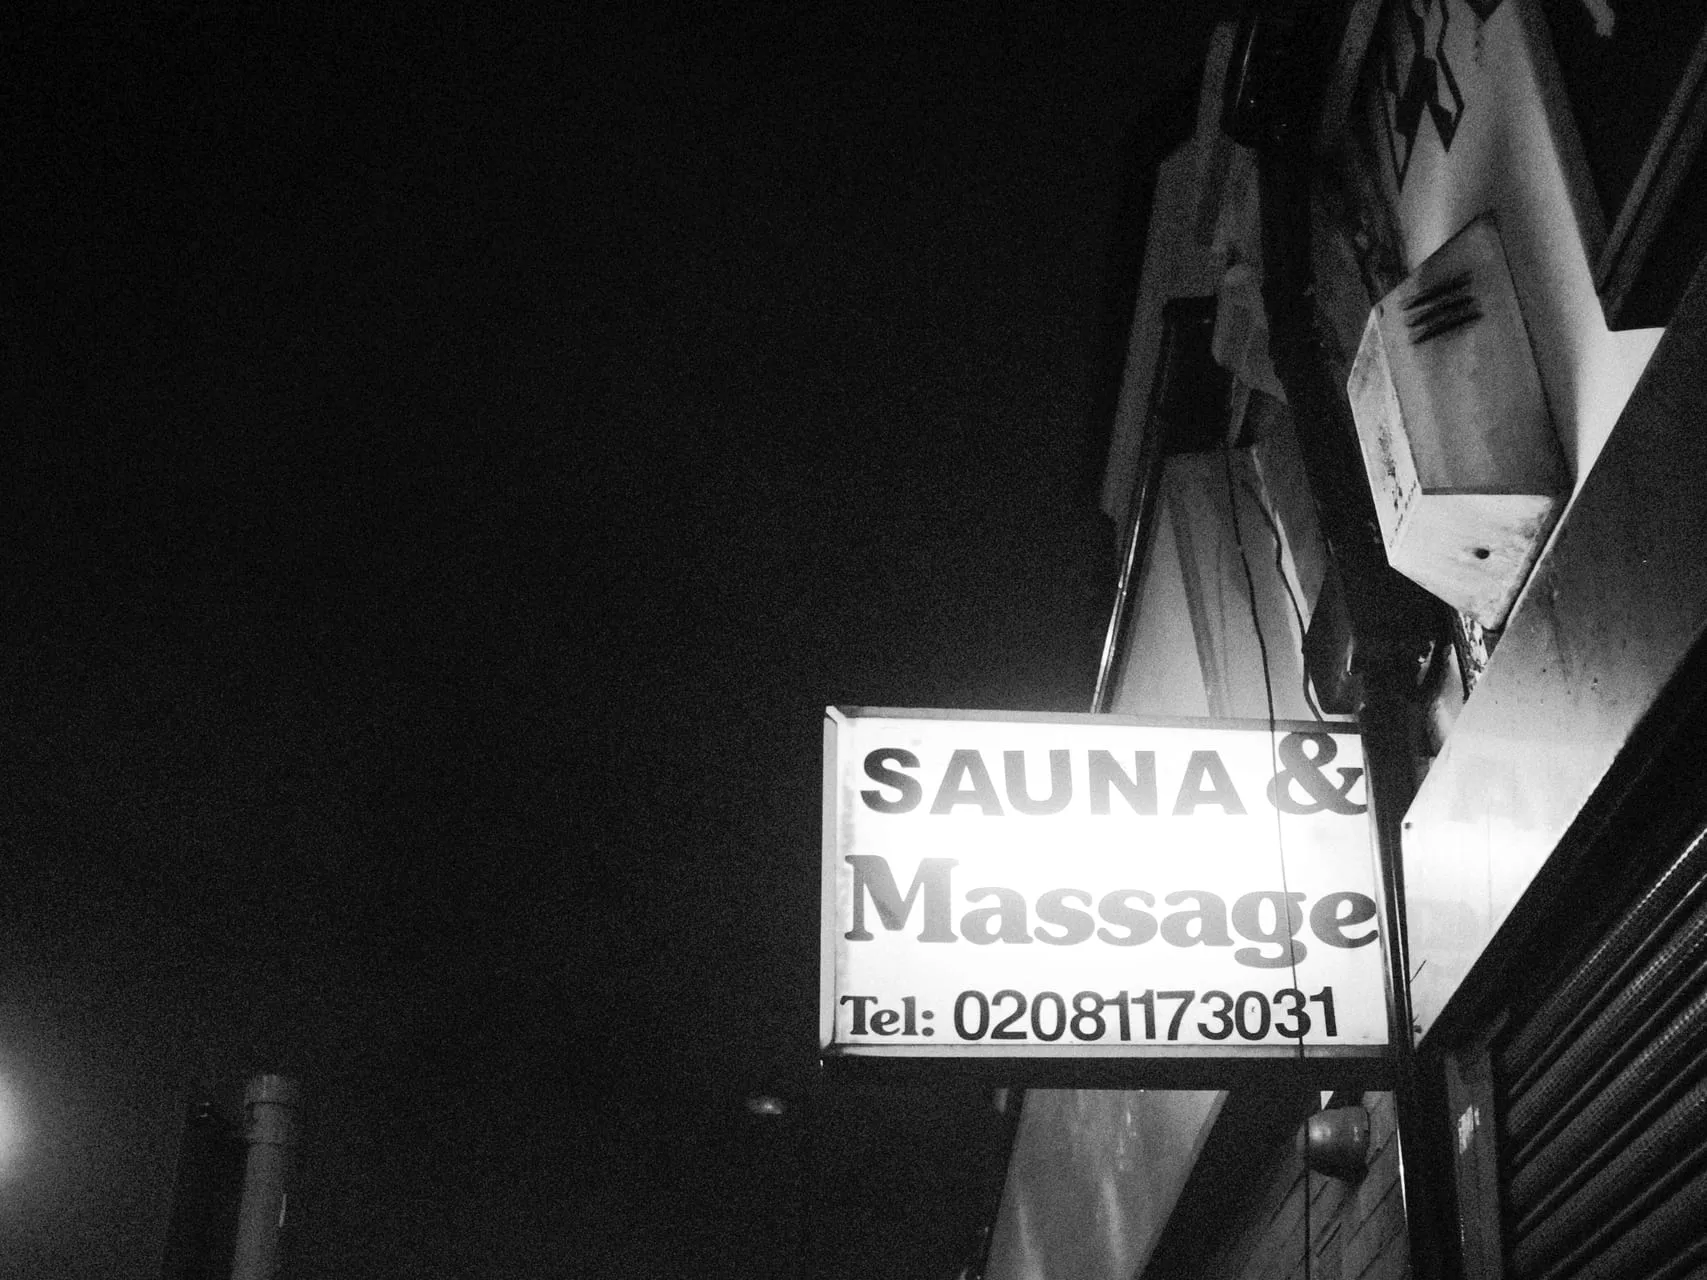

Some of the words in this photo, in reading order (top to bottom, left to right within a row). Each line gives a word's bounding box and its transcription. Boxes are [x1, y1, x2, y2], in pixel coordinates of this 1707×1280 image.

[860, 747, 1248, 816] SAUNA
[1266, 732, 1368, 815] &
[844, 854, 1379, 969] Massage
[840, 995, 935, 1037] Tel:
[953, 986, 1339, 1043] 02081173031
